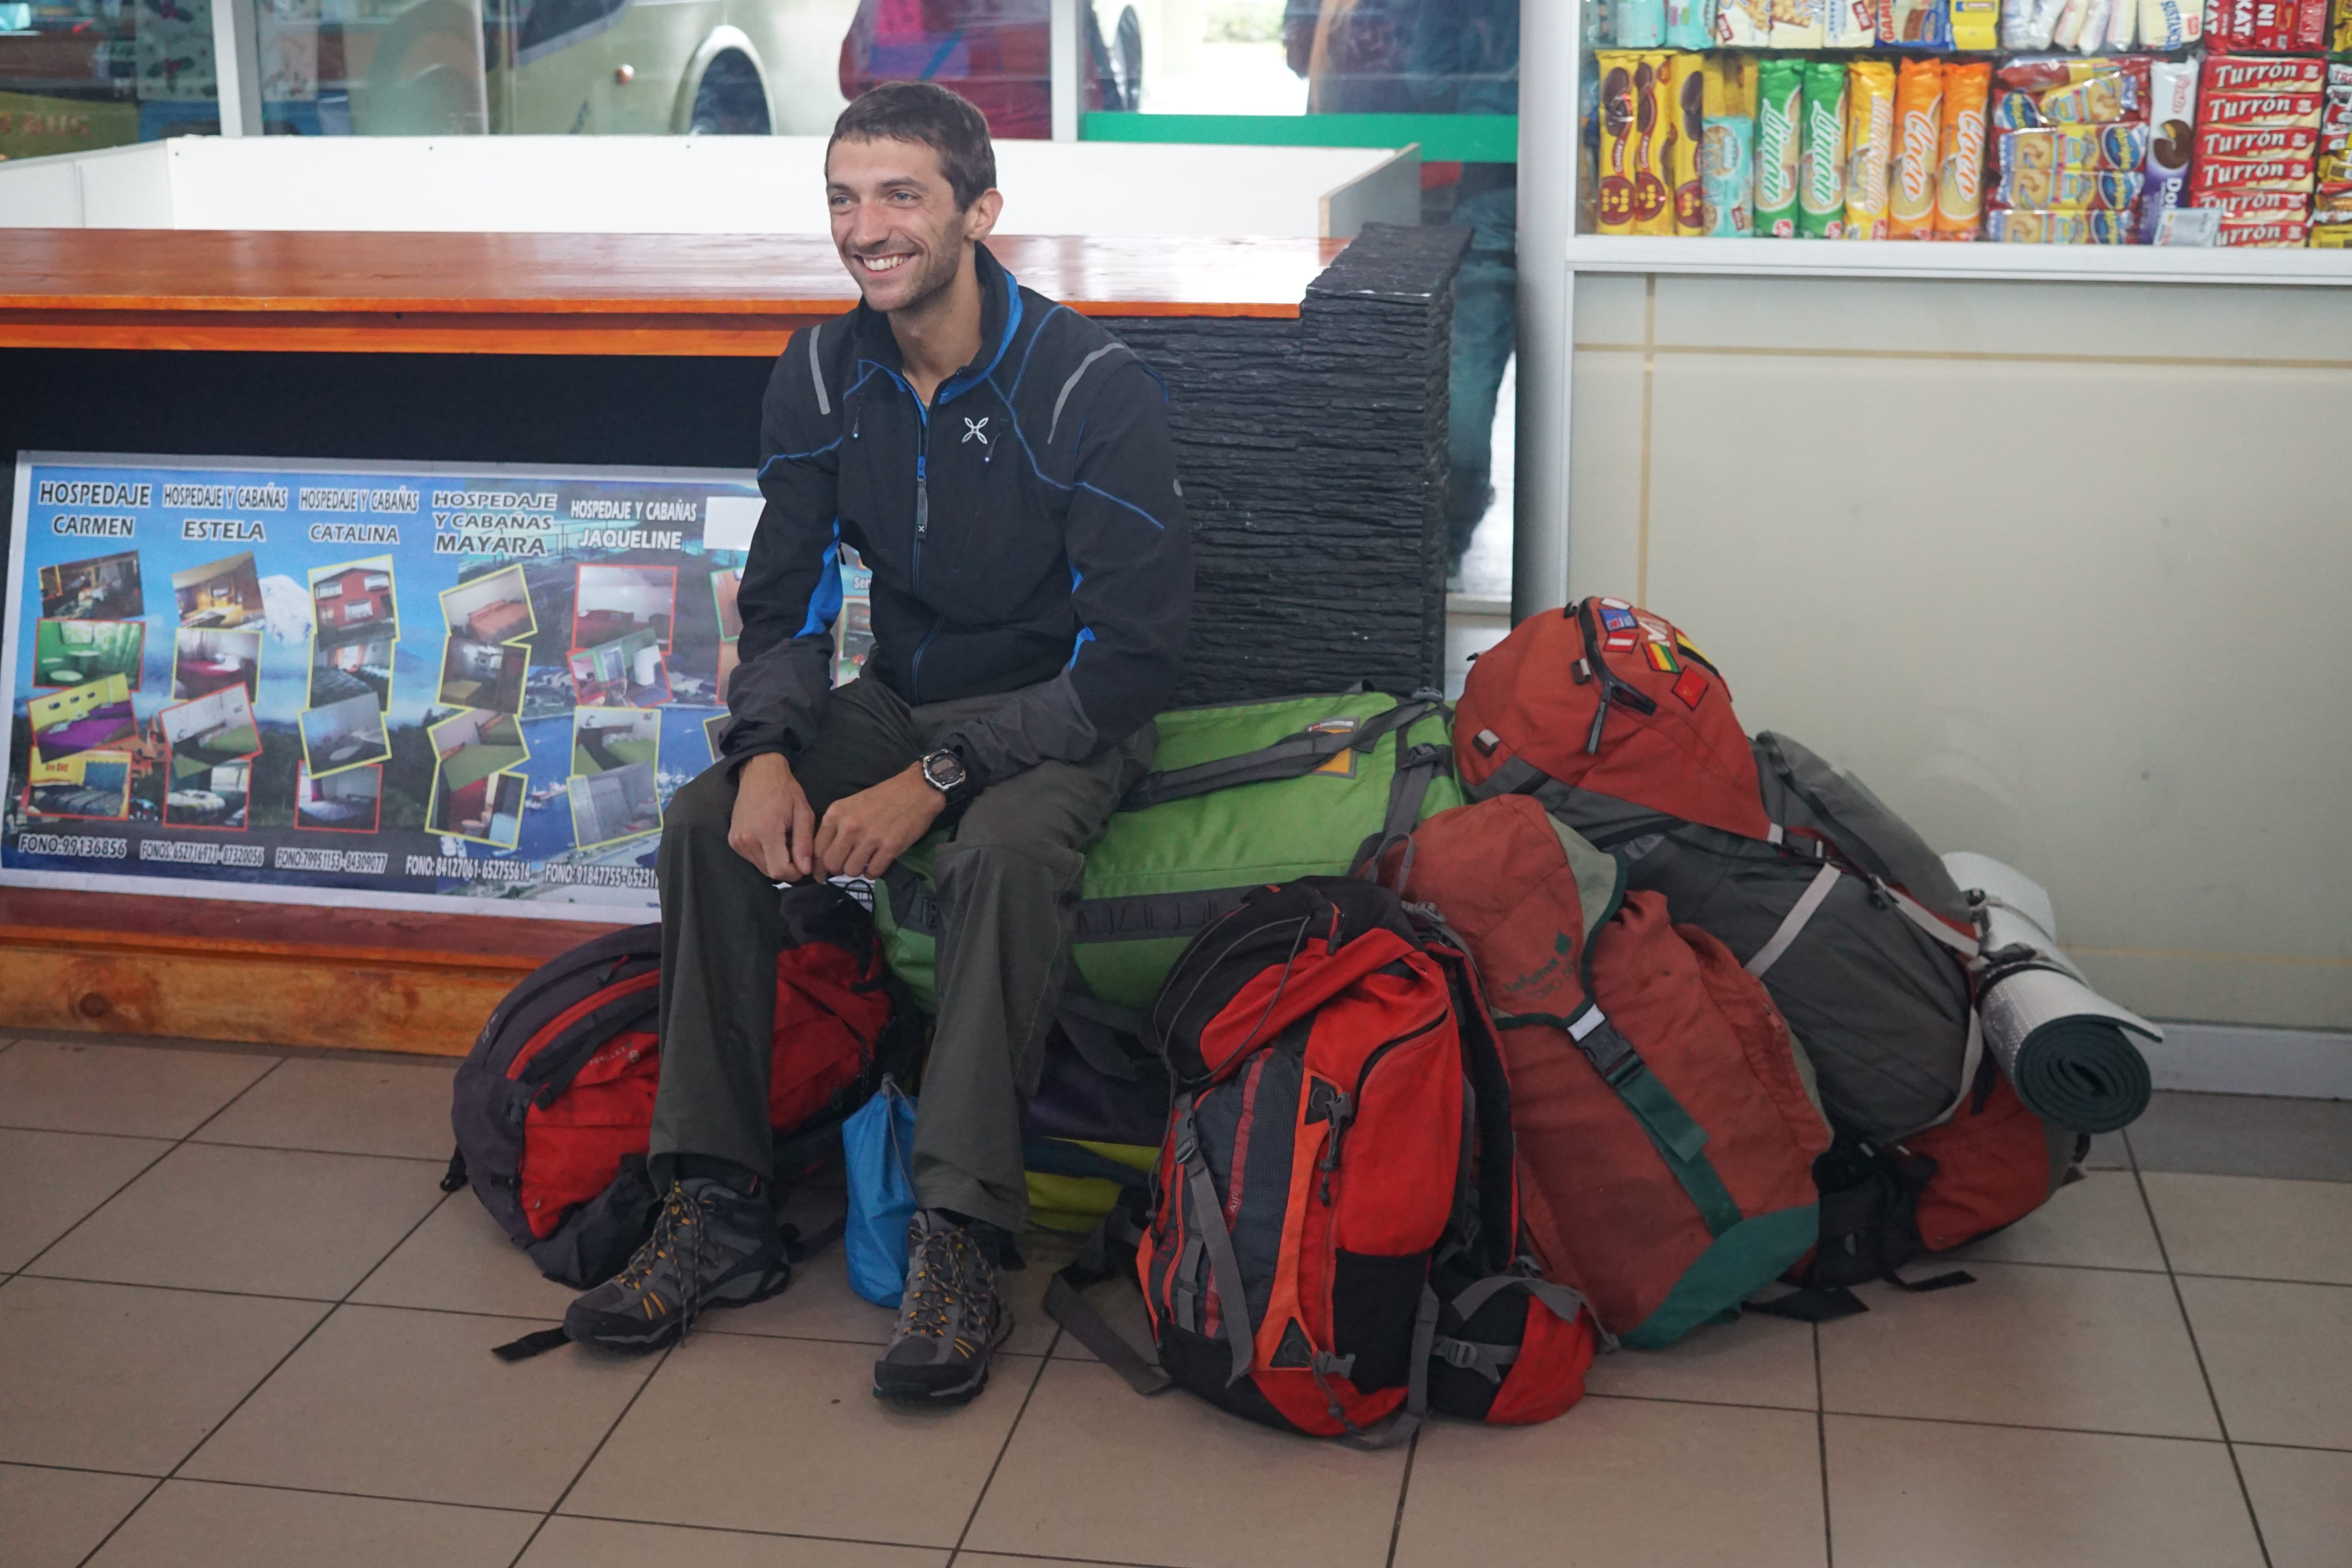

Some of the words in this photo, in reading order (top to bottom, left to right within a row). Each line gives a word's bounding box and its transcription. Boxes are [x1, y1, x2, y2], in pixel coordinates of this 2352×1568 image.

[2216, 61, 2298, 88] Turrón
[2209, 94, 2291, 122] Turrón
[1762, 98, 1793, 203] Limón
[1813, 100, 1842, 206] Limón
[2204, 130, 2286, 155] Turrón
[1901, 111, 1936, 201] Coco
[1955, 110, 1984, 202] Coco
[2203, 160, 2284, 187] Turrón
[2216, 224, 2281, 246] urrón
[40, 483, 151, 506] HOSPEDAJE
[164, 486, 223, 507] HOSPEDAJE
[227, 487, 235, 507] Y
[237, 484, 287, 509] CABAÑAS
[300, 490, 357, 510] HOSPEDAJE
[361, 491, 368, 510] Y
[371, 488, 419, 512] CABAÑAS
[434, 493, 557, 509] HOSPEDAJE
[435, 514, 449, 527] Y
[452, 512, 552, 530] CABAÑAS
[570, 500, 632, 520] HOSPEDAJE
[635, 501, 644, 520] Y
[646, 498, 697, 521] CABAÑAS
[53, 515, 134, 536] CARMEN
[183, 521, 265, 540] ESTELA
[310, 525, 398, 543] CATALINA
[435, 535, 546, 554] MAYARA
[579, 529, 683, 550] JAQUELINE
[1229, 1191, 1239, 1212] AIR
